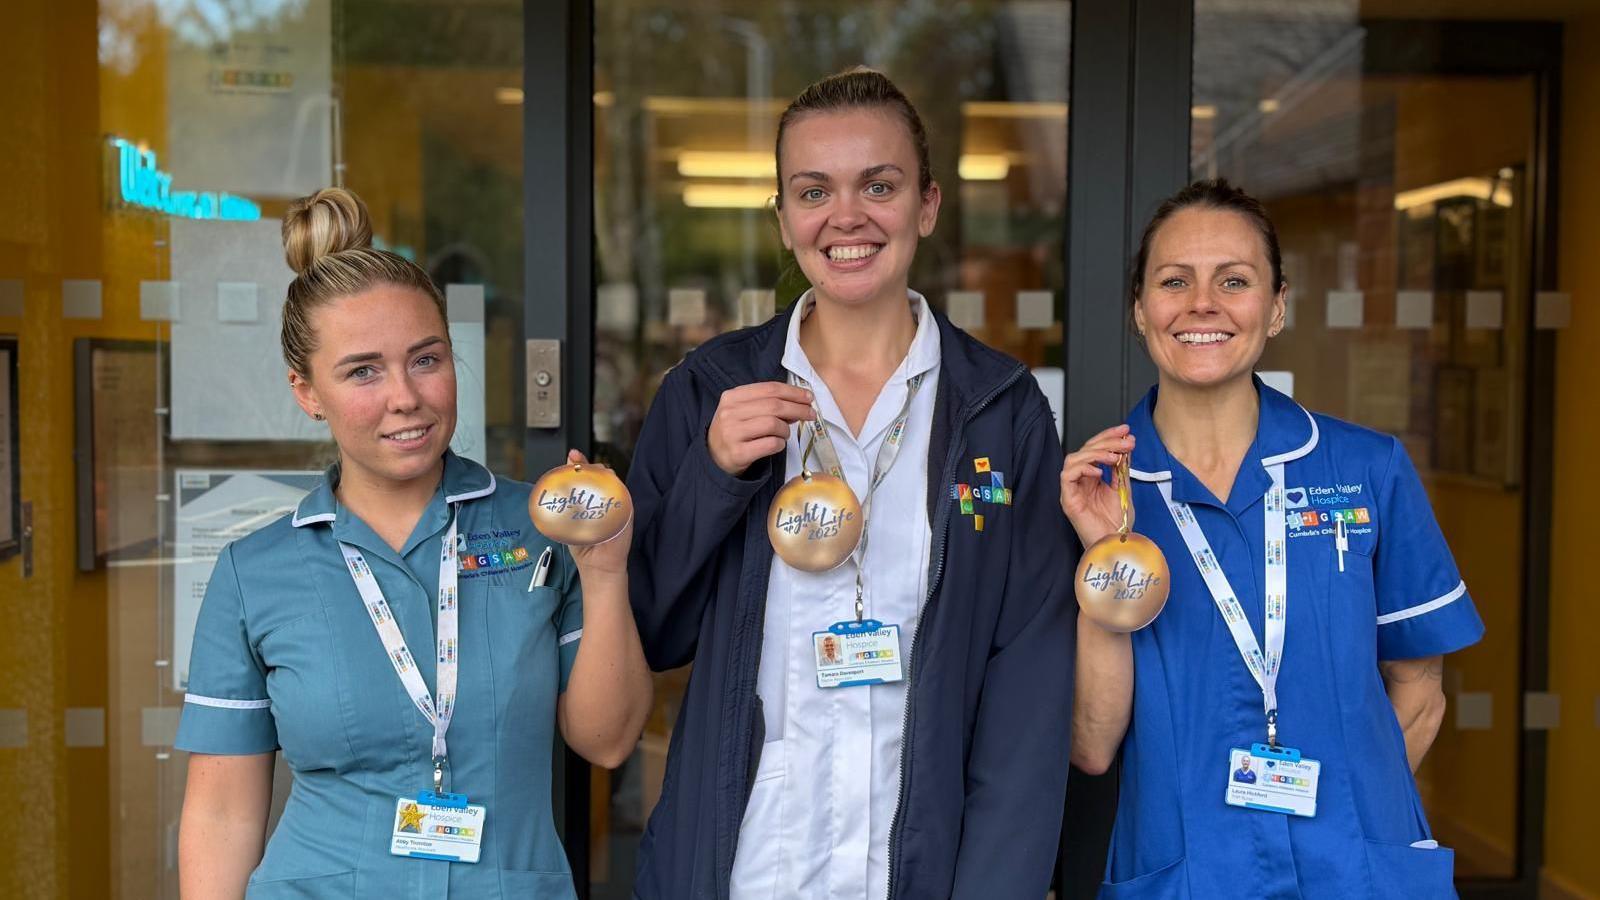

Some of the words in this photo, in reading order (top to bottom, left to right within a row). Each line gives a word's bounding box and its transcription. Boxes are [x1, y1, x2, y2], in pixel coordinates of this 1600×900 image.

[1309, 486, 1334, 495] Eden
[1336, 483, 1362, 494] Valley
[537, 488, 586, 513] Light
[586, 494, 622, 513] Life
[1312, 494, 1350, 505] Hospice
[571, 510, 604, 520] 2025
[776, 502, 819, 534] Light
[820, 507, 853, 528] Life
[492, 529, 520, 538] Valley
[784, 525, 794, 534] up
[808, 525, 838, 540] 2025
[460, 547, 528, 568] IGSAW
[1083, 560, 1128, 591] Light
[1127, 568, 1160, 591] Life
[1113, 589, 1144, 599] 2025
[868, 628, 891, 637] Valley
[452, 806, 479, 816] Valley
